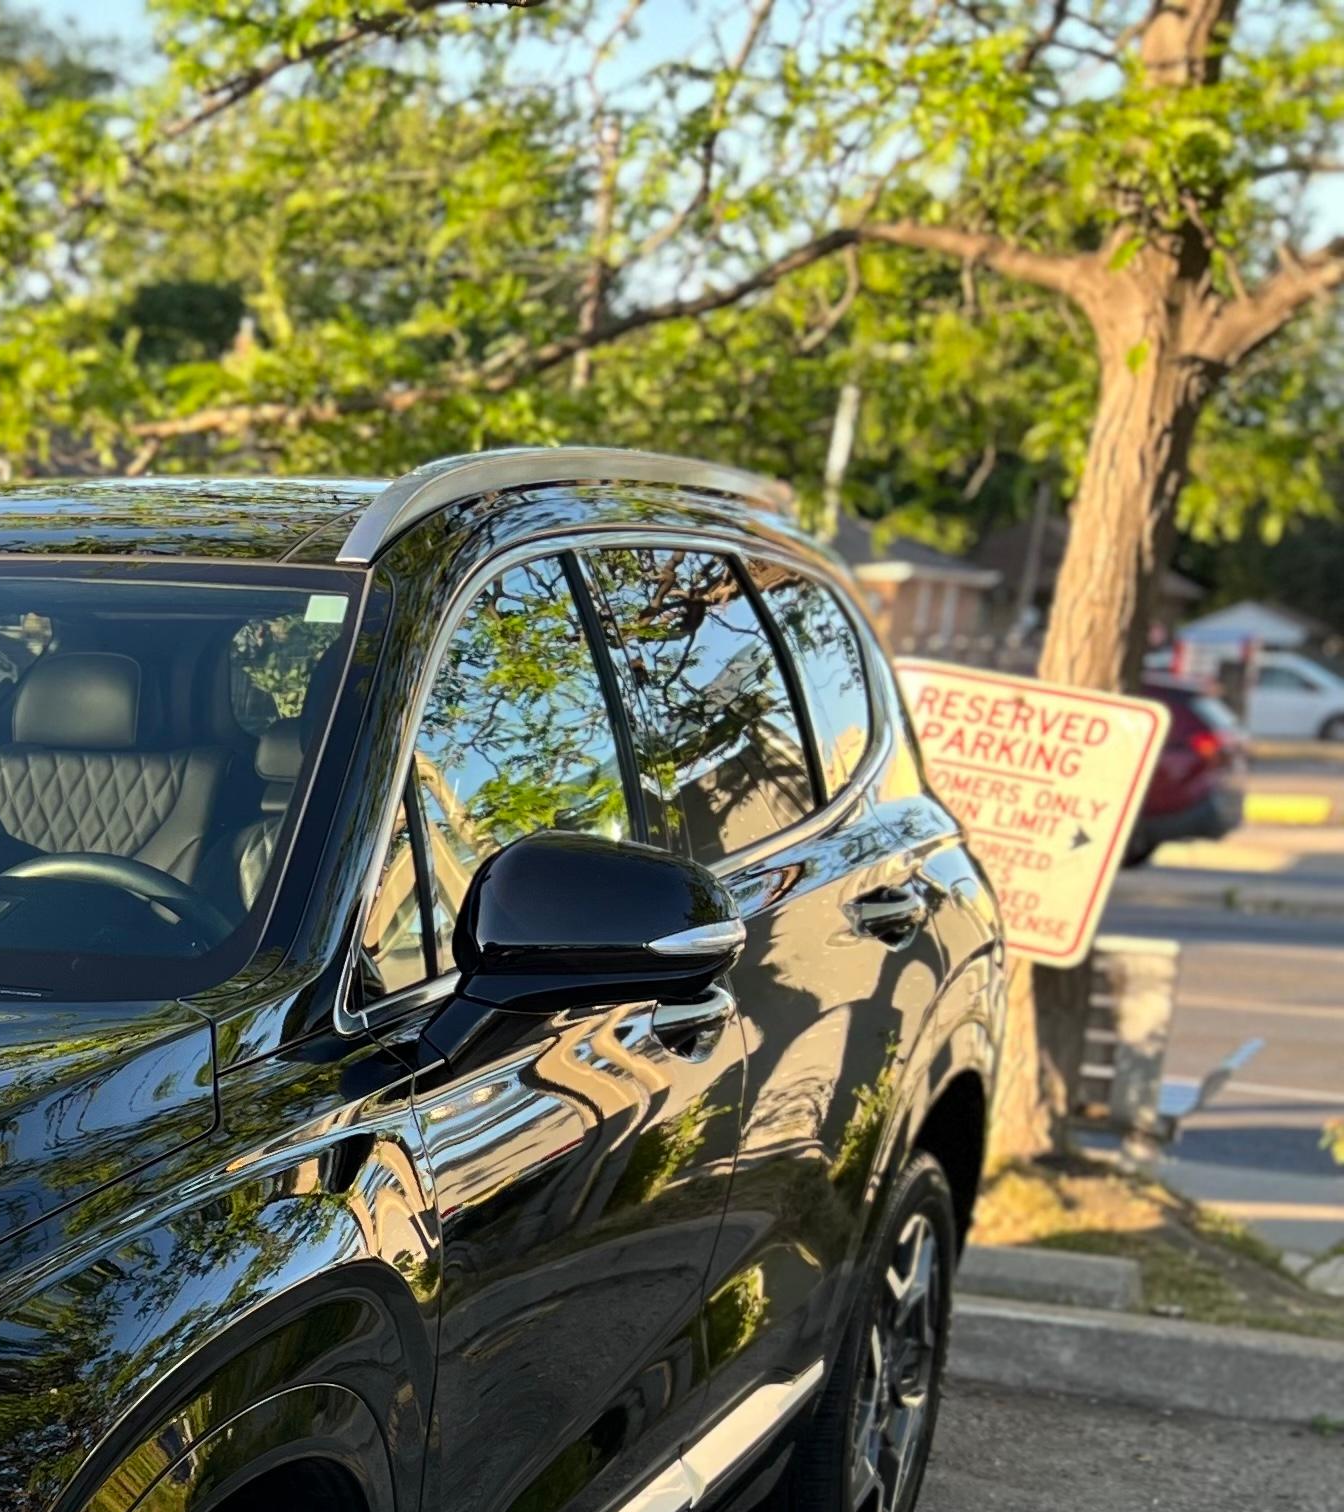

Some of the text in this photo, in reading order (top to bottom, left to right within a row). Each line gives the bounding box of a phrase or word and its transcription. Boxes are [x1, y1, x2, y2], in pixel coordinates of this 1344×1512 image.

[915, 685, 1110, 747] RESERVED
[919, 721, 1082, 778] PARKING
[927, 767, 1109, 821] OMERS ONLY
[993, 806, 1063, 837] LIMIT
